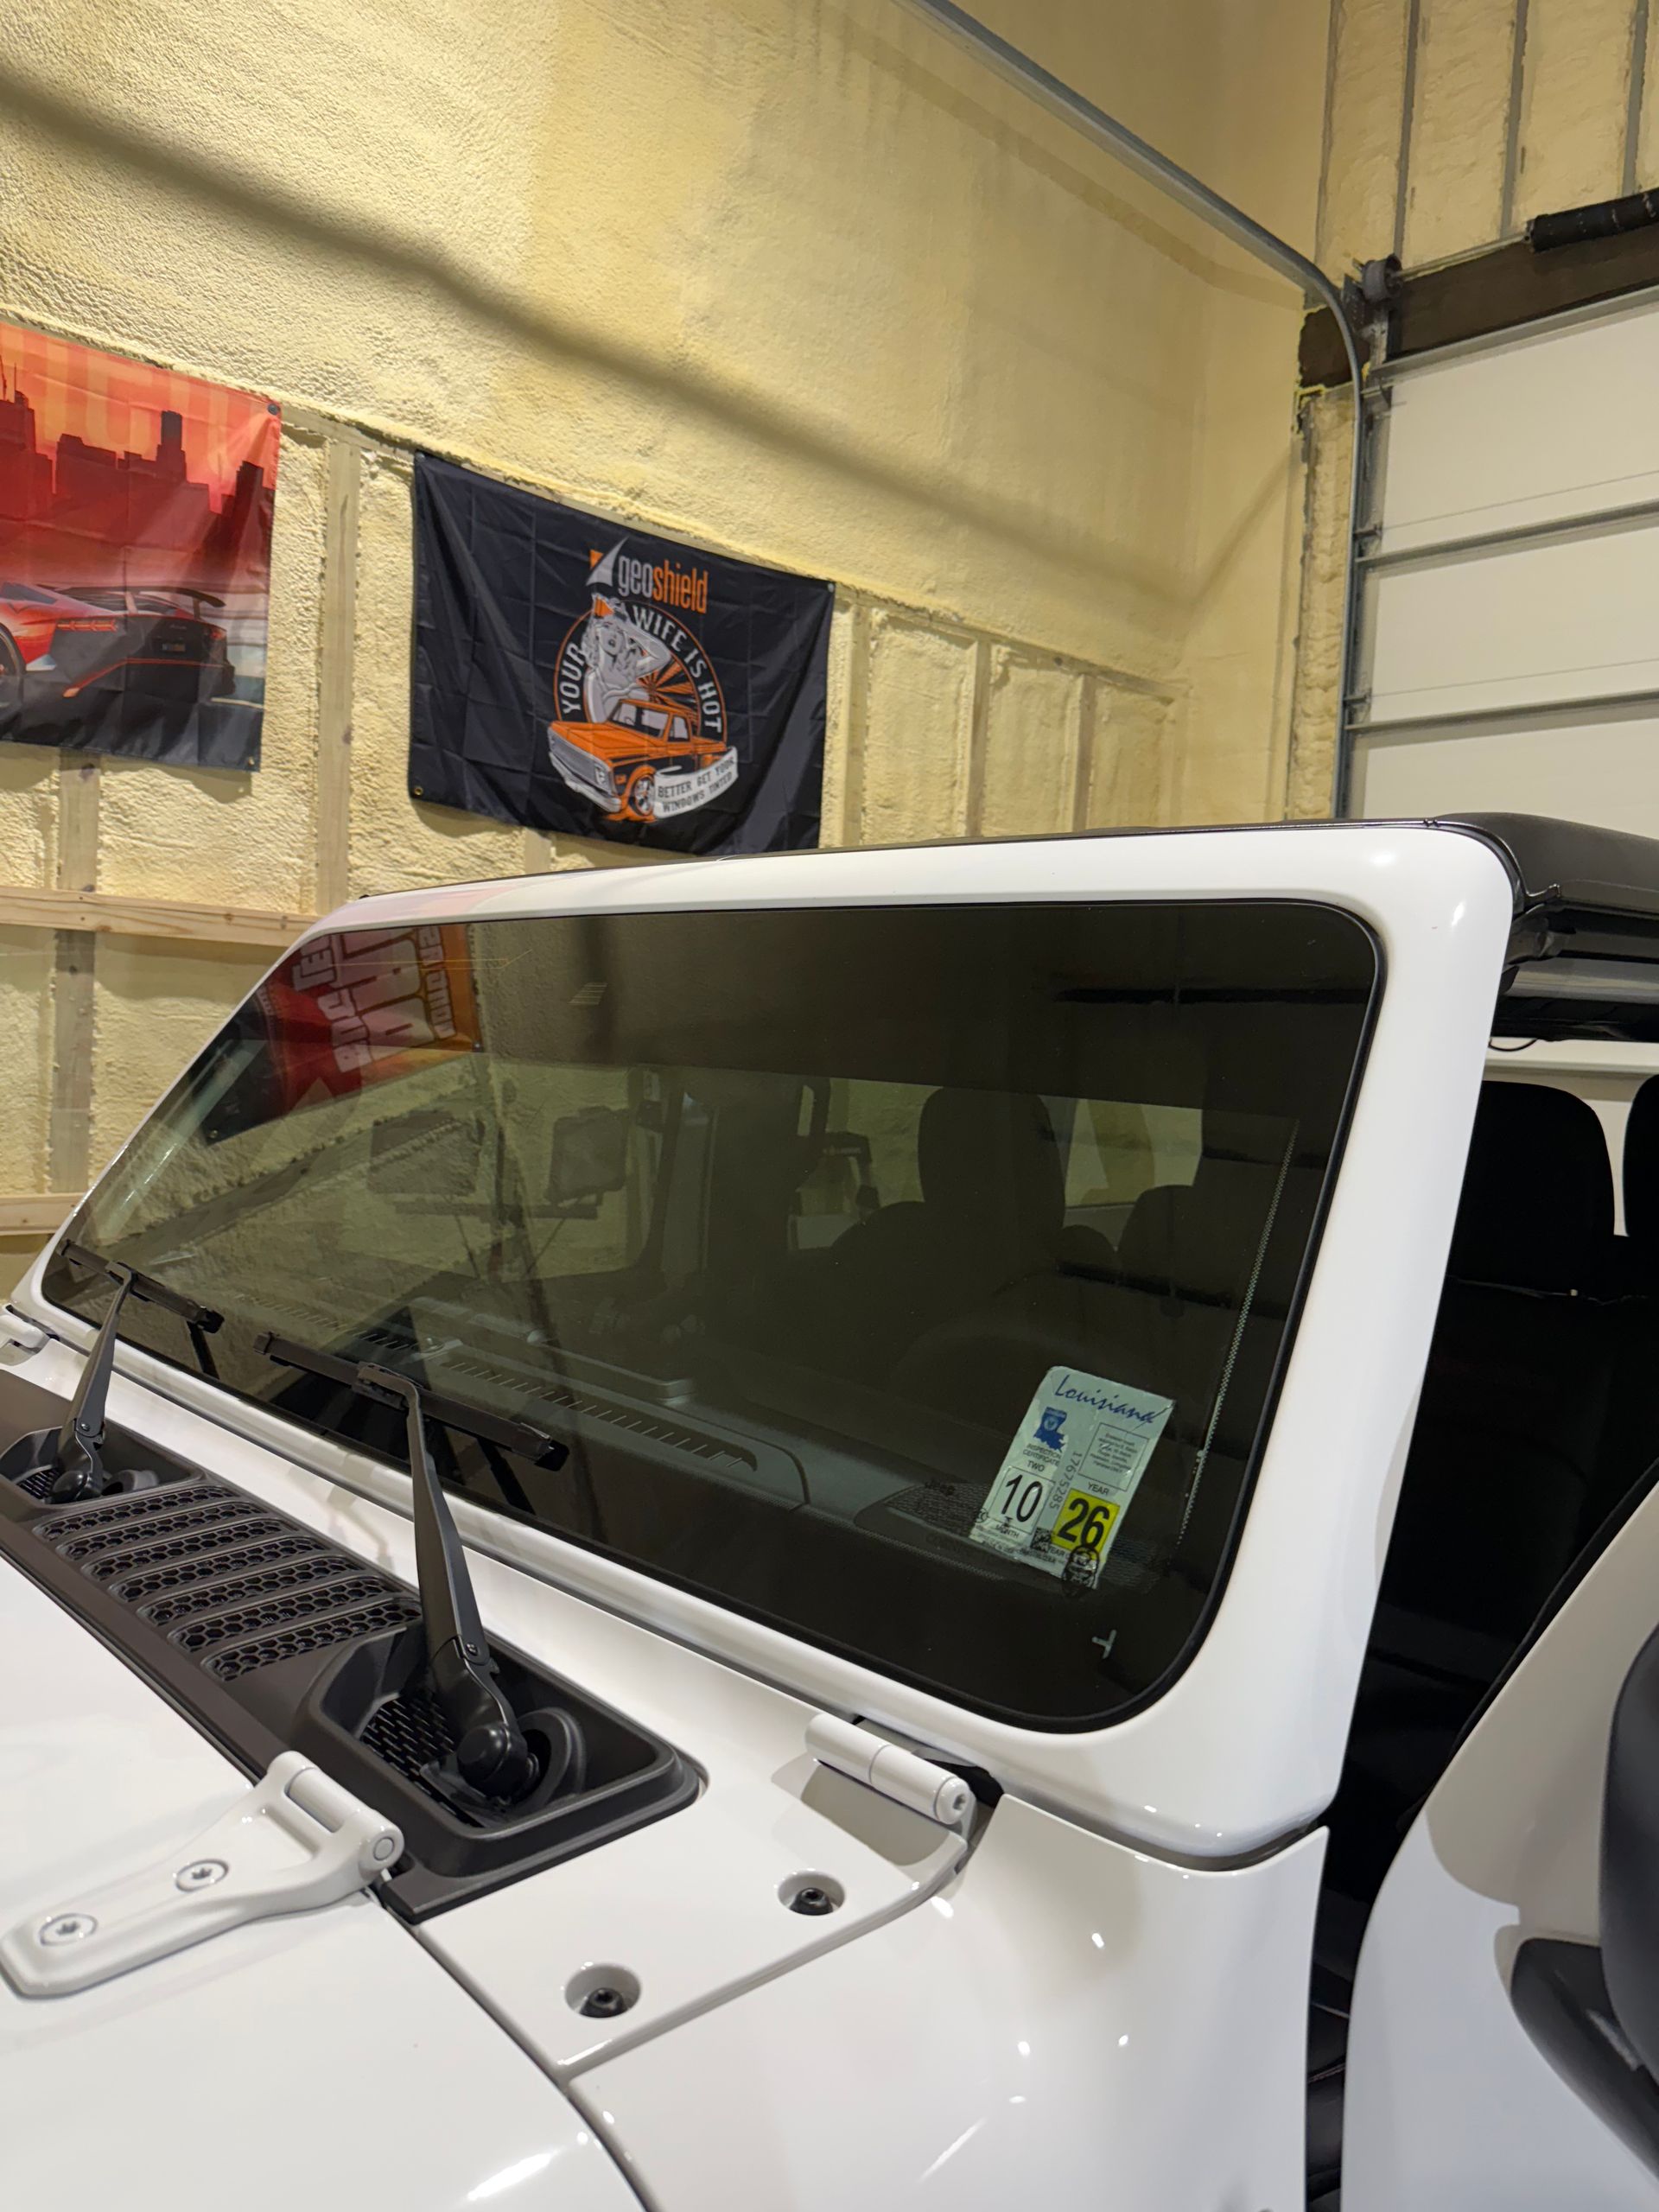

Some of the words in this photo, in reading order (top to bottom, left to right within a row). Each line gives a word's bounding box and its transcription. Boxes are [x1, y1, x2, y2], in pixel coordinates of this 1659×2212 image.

[618, 555, 709, 614] geoshield
[631, 604, 688, 652] WIFE
[559, 642, 588, 715] YOUR
[684, 649, 709, 679] IS
[696, 682, 723, 734] HOT
[658, 780, 692, 798] BETTER
[696, 771, 712, 787] GET
[714, 758, 735, 776] YOUR
[662, 790, 705, 813] WINDOWS
[709, 771, 733, 793] TINTED
[1055, 1374, 1156, 1424] Louisiana
[1023, 1449, 1060, 1466] CERTIFICATE
[1027, 1443, 1062, 1460] INSPECTION
[1027, 1460, 1046, 1472] TWO
[1002, 1474, 1043, 1522] 10
[1049, 1451, 1083, 1510] 17675285
[1087, 1482, 1109, 1497] YEAR
[1058, 1497, 1110, 1548] 26
